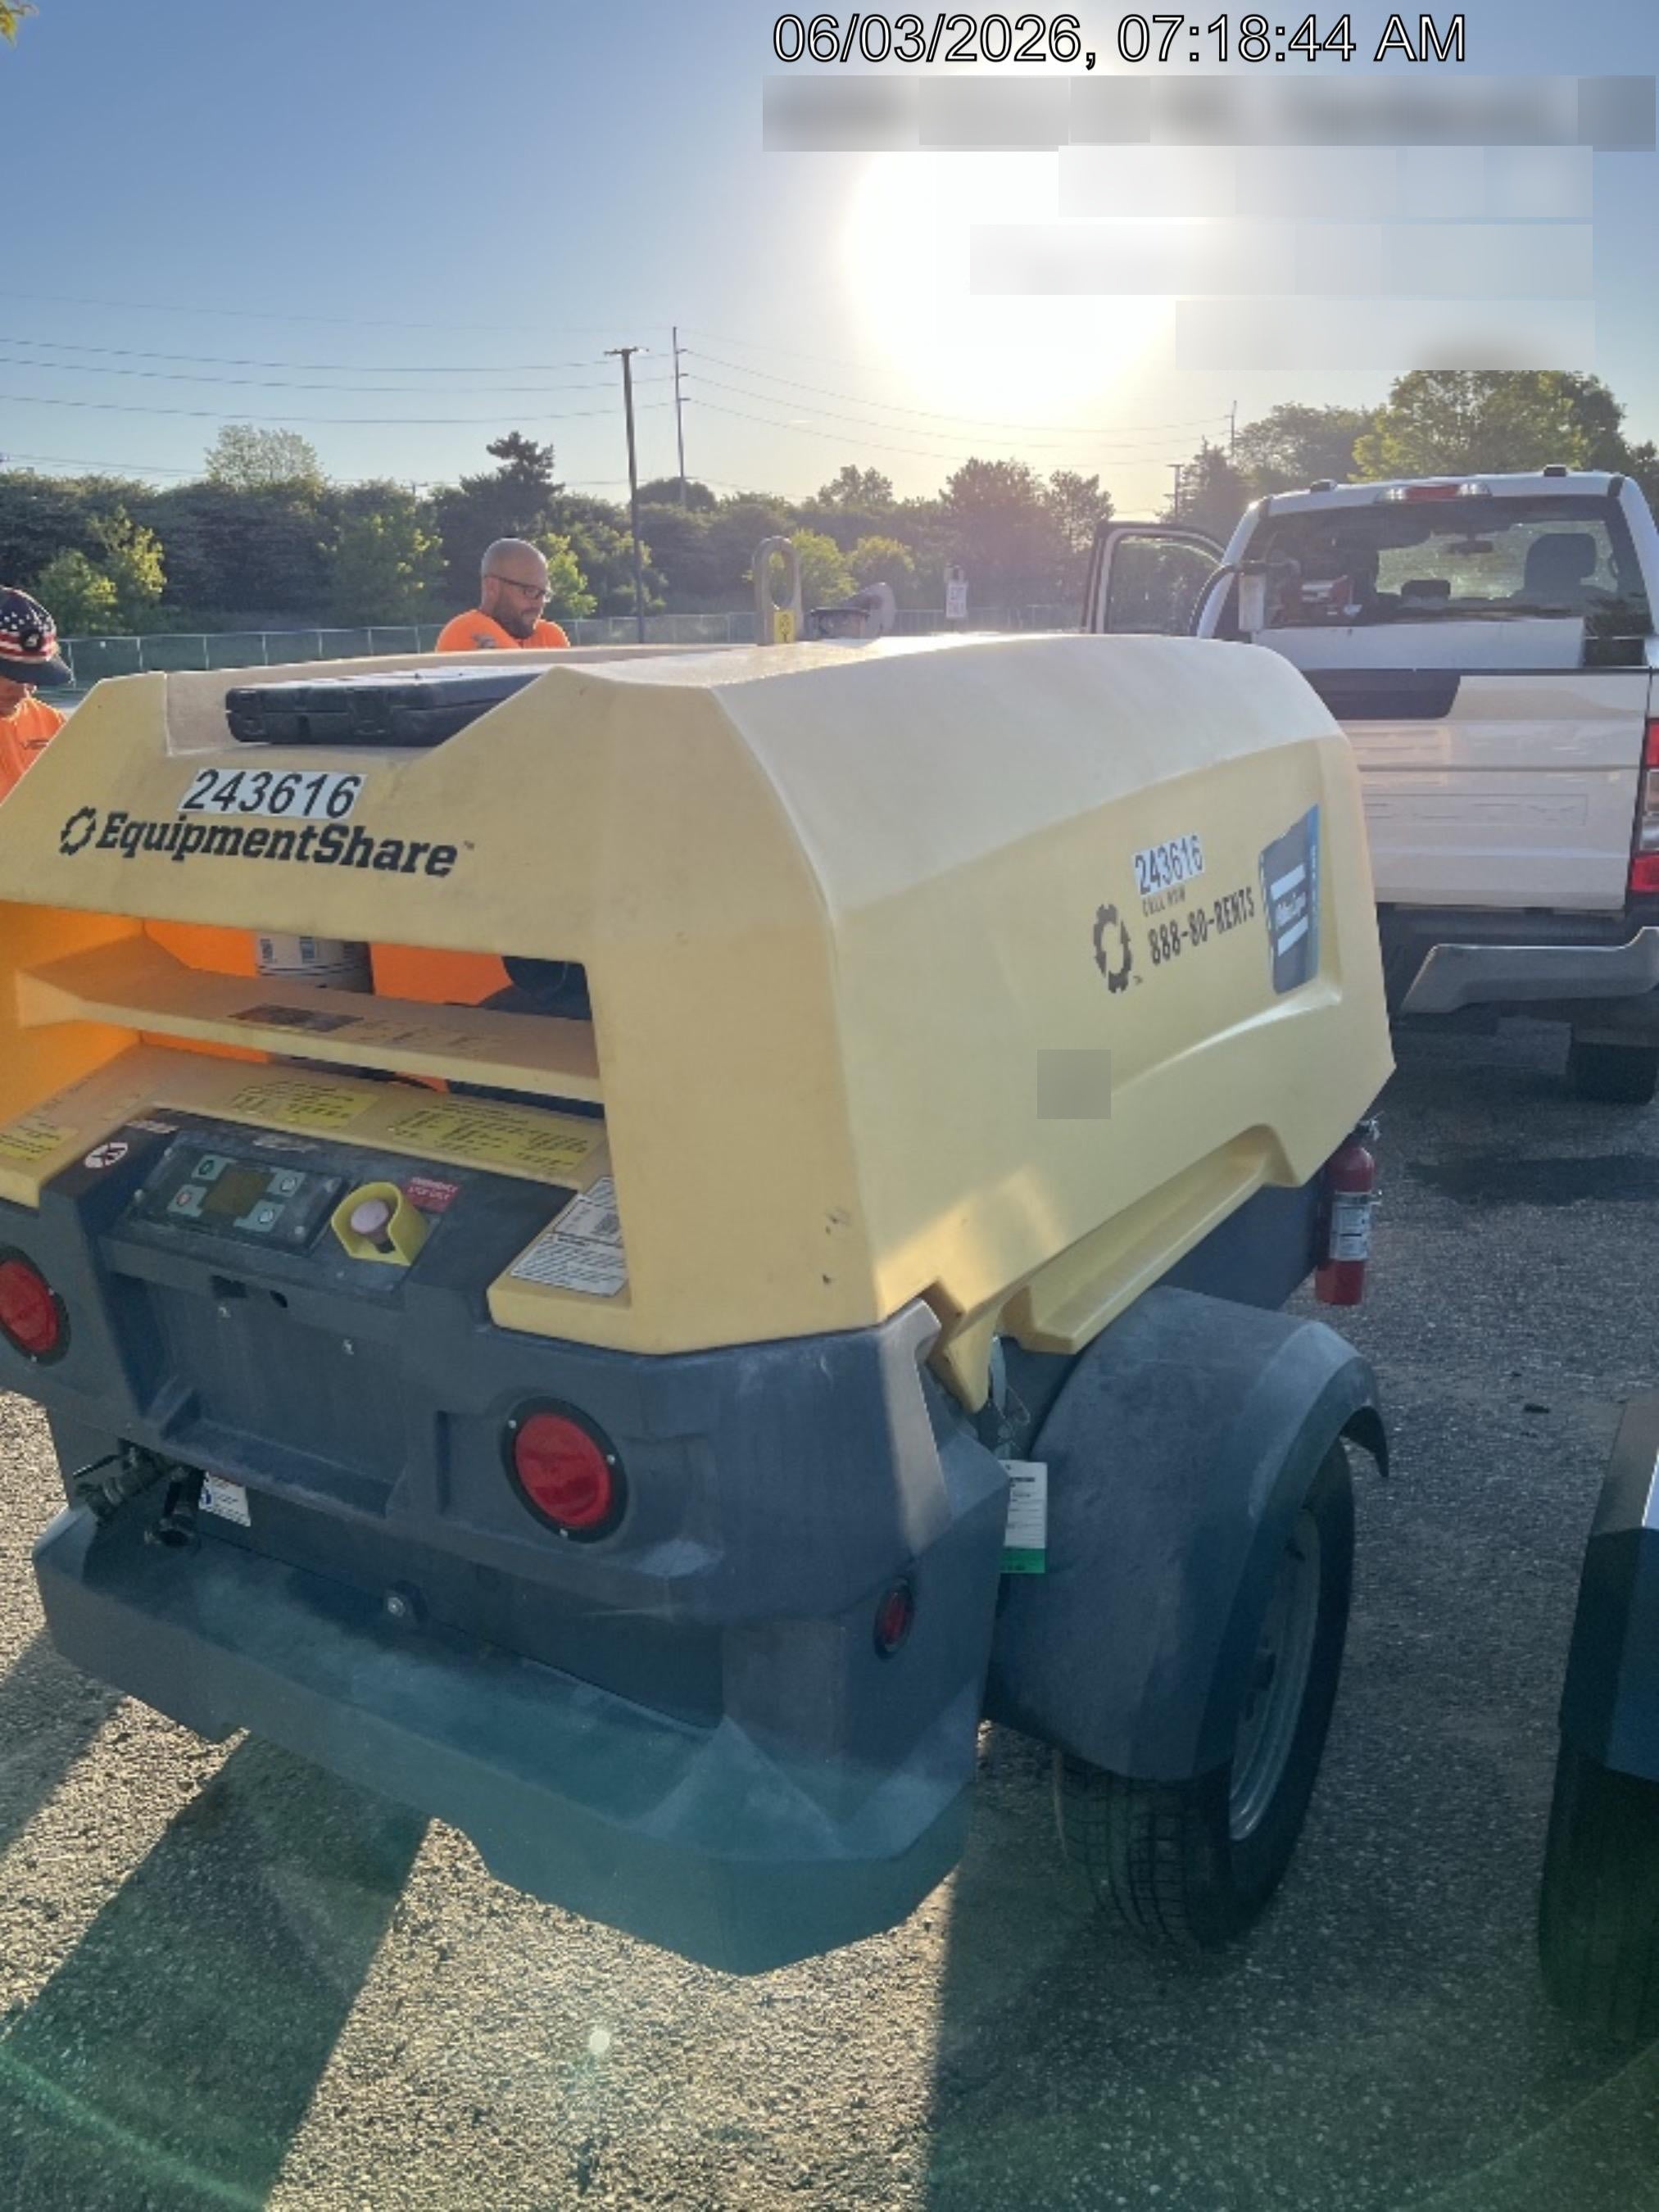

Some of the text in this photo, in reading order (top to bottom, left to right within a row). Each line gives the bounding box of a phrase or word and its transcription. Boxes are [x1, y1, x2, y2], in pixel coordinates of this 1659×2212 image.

[183, 768, 361, 818] 243616
[95, 812, 458, 877] EquipmentShare
[1135, 835, 1203, 895] 243616
[1149, 886, 1254, 966] 888-80-RENTS
